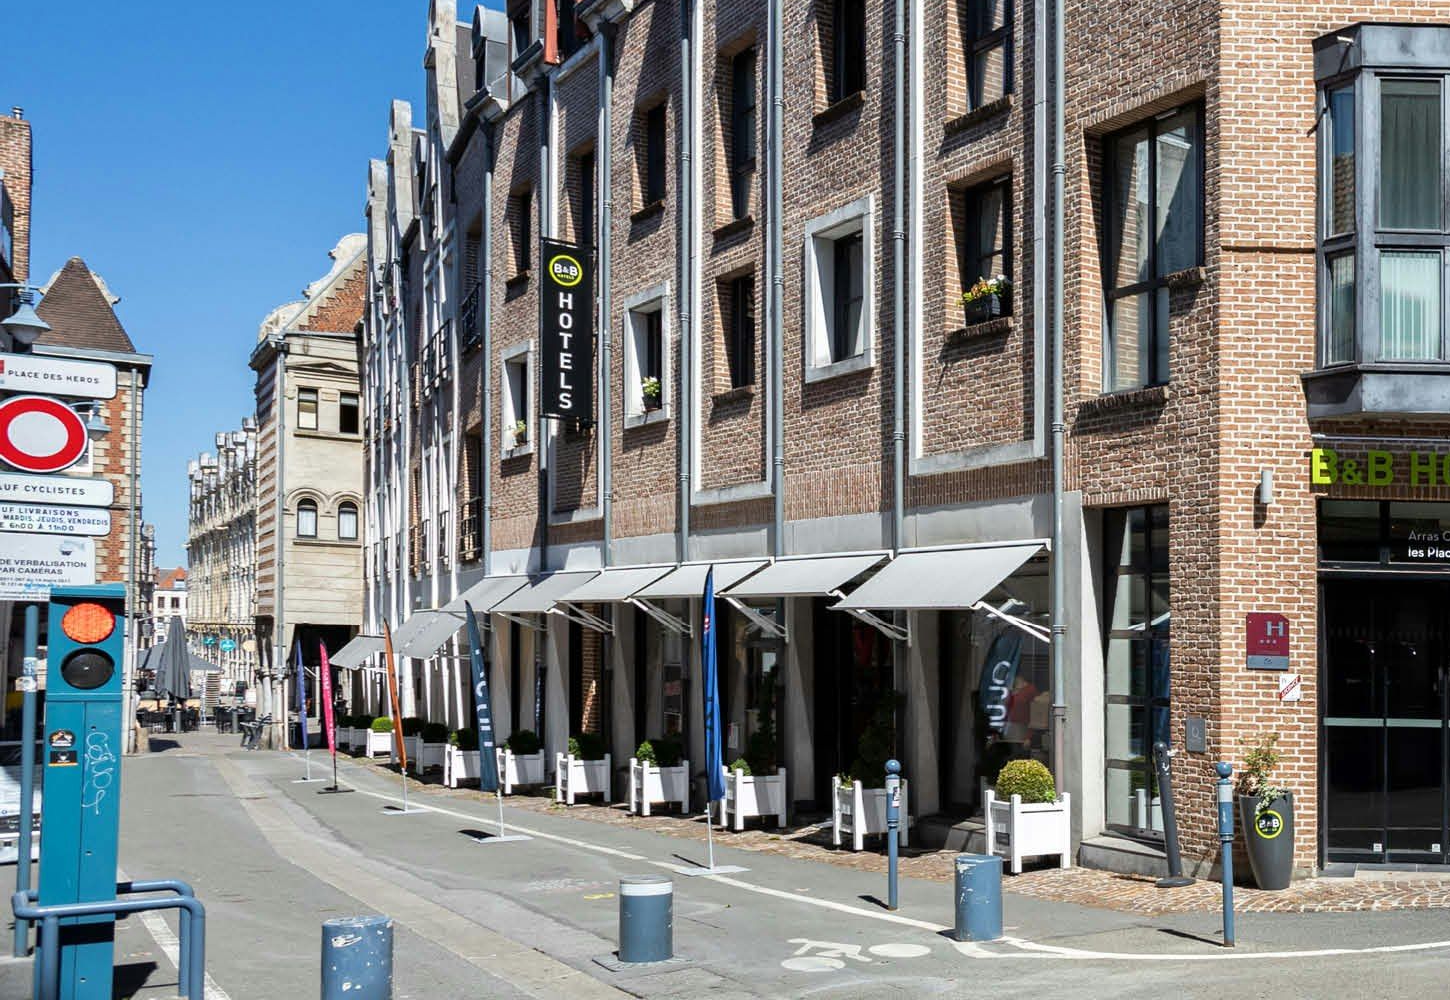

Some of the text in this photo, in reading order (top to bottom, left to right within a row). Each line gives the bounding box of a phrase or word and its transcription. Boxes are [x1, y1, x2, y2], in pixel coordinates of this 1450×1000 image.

[554, 263, 578, 277] B&B
[559, 292, 573, 409] HOTELS
[8, 369, 39, 379] PLACE
[43, 373, 62, 381] DES
[1311, 448, 1394, 486] B&B
[24, 485, 86, 495] CYCLISTES
[19, 508, 80, 517] LIVRAISONS
[68, 518, 108, 526] VENDREDIS
[1408, 531, 1439, 543] Arras
[1408, 547, 1424, 558] les
[15, 560, 87, 568] VERBALISATION
